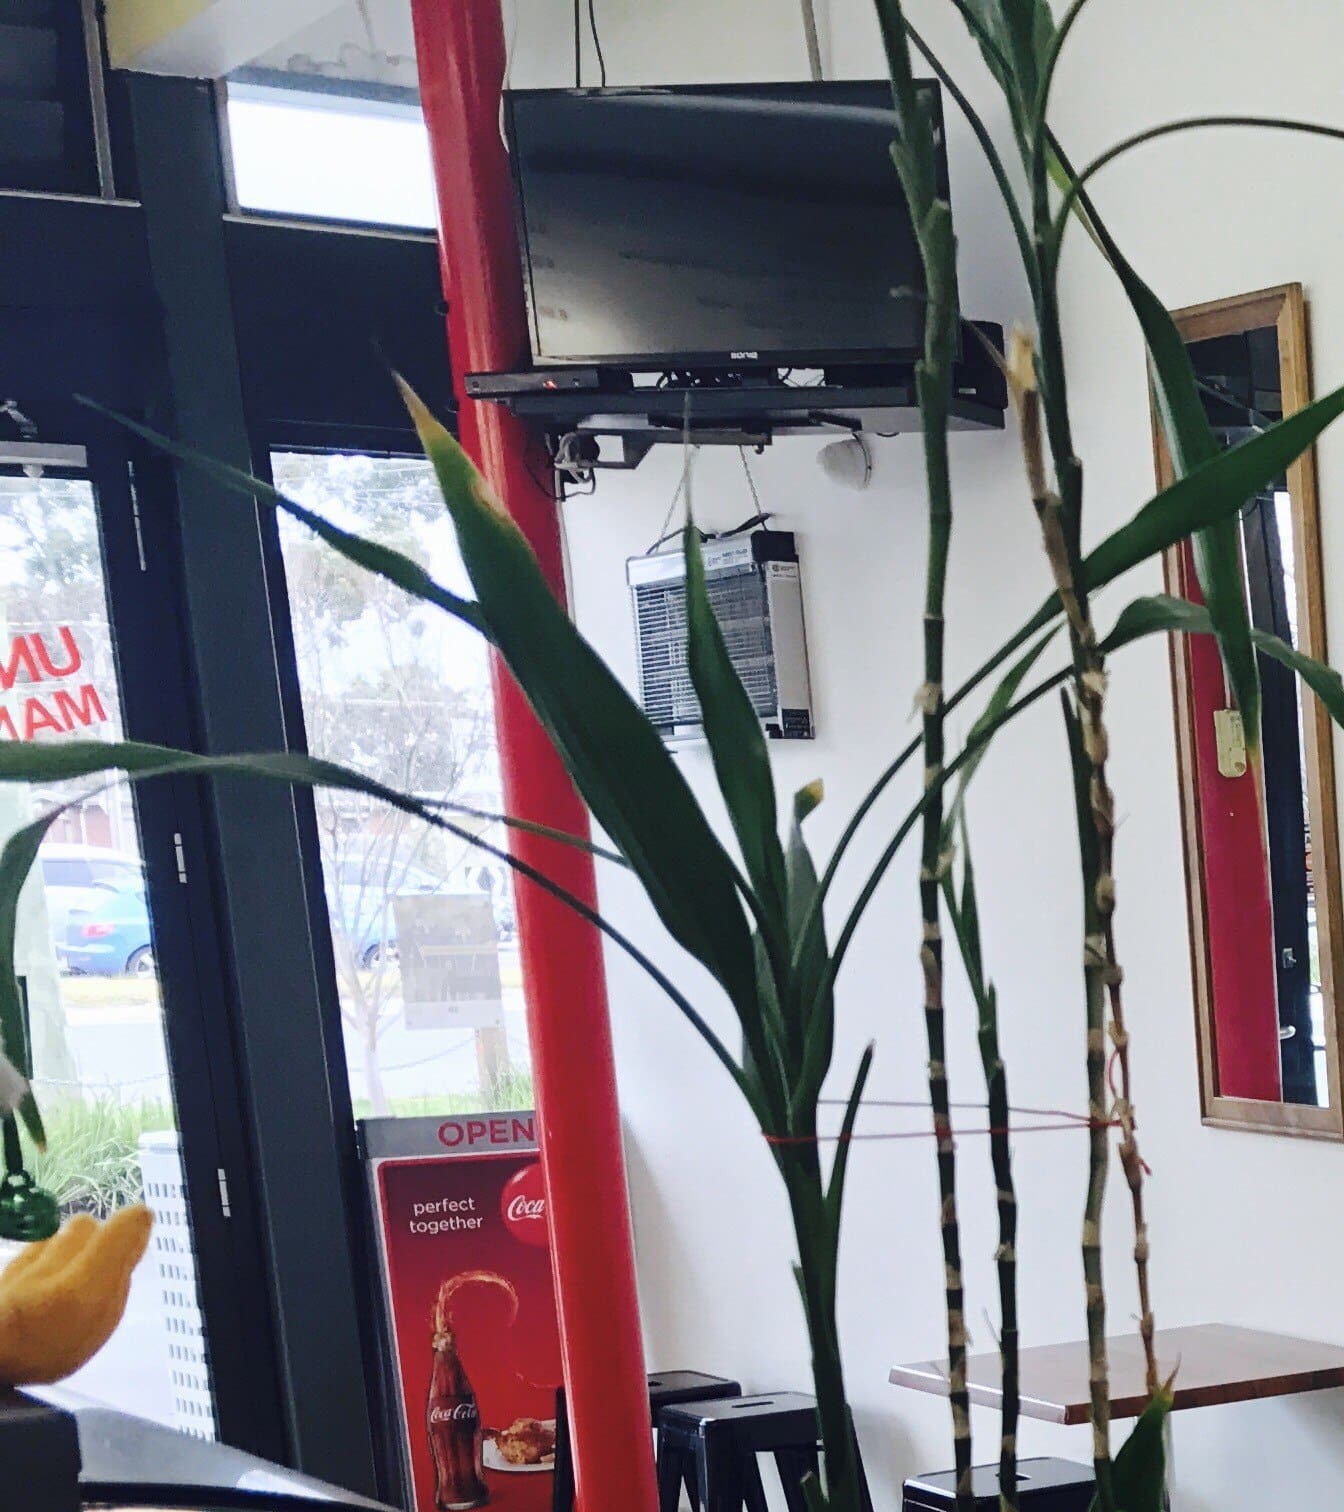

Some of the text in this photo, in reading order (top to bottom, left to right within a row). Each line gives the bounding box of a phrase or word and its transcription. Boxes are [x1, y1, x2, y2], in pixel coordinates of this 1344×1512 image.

[437, 1118, 535, 1147] OPEN
[413, 1197, 476, 1217] perfect
[409, 1216, 483, 1235] together
